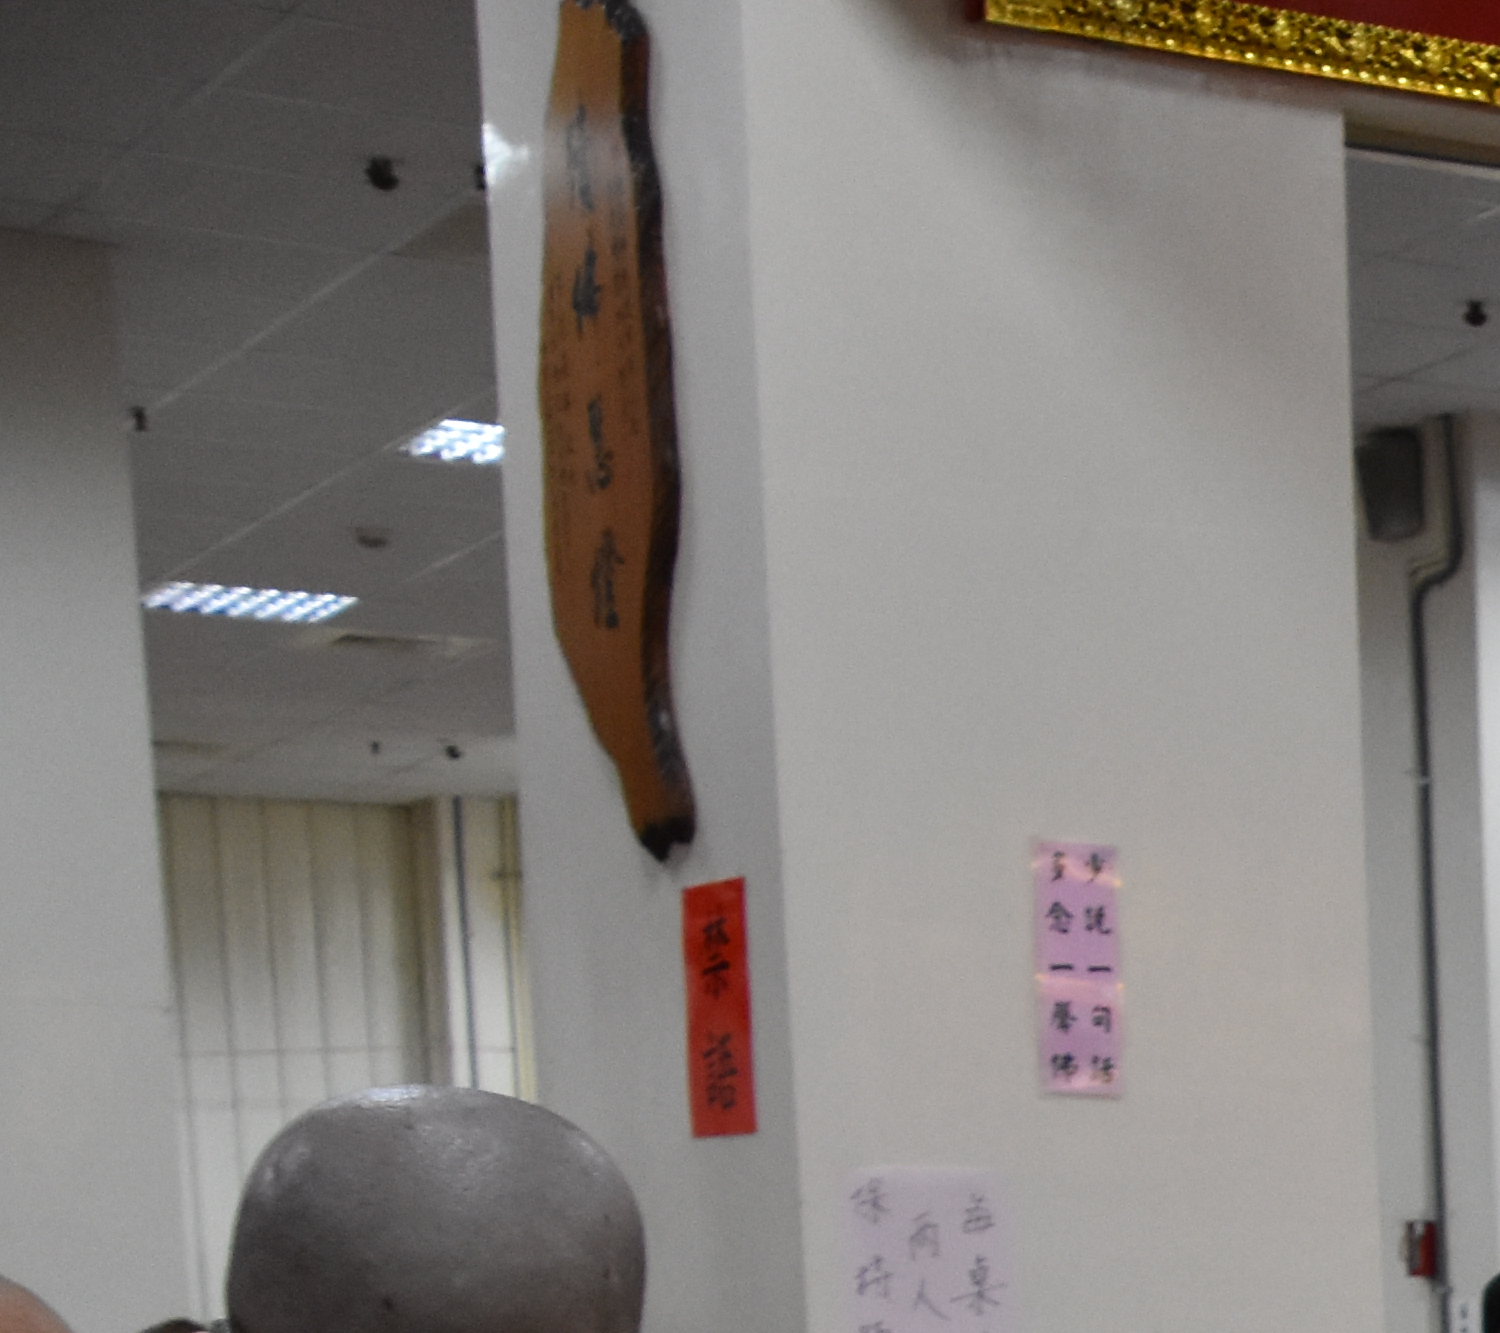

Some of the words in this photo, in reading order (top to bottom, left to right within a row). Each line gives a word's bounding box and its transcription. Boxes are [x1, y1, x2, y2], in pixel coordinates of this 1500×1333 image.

[1084, 853, 1114, 1083] 少說一句話
